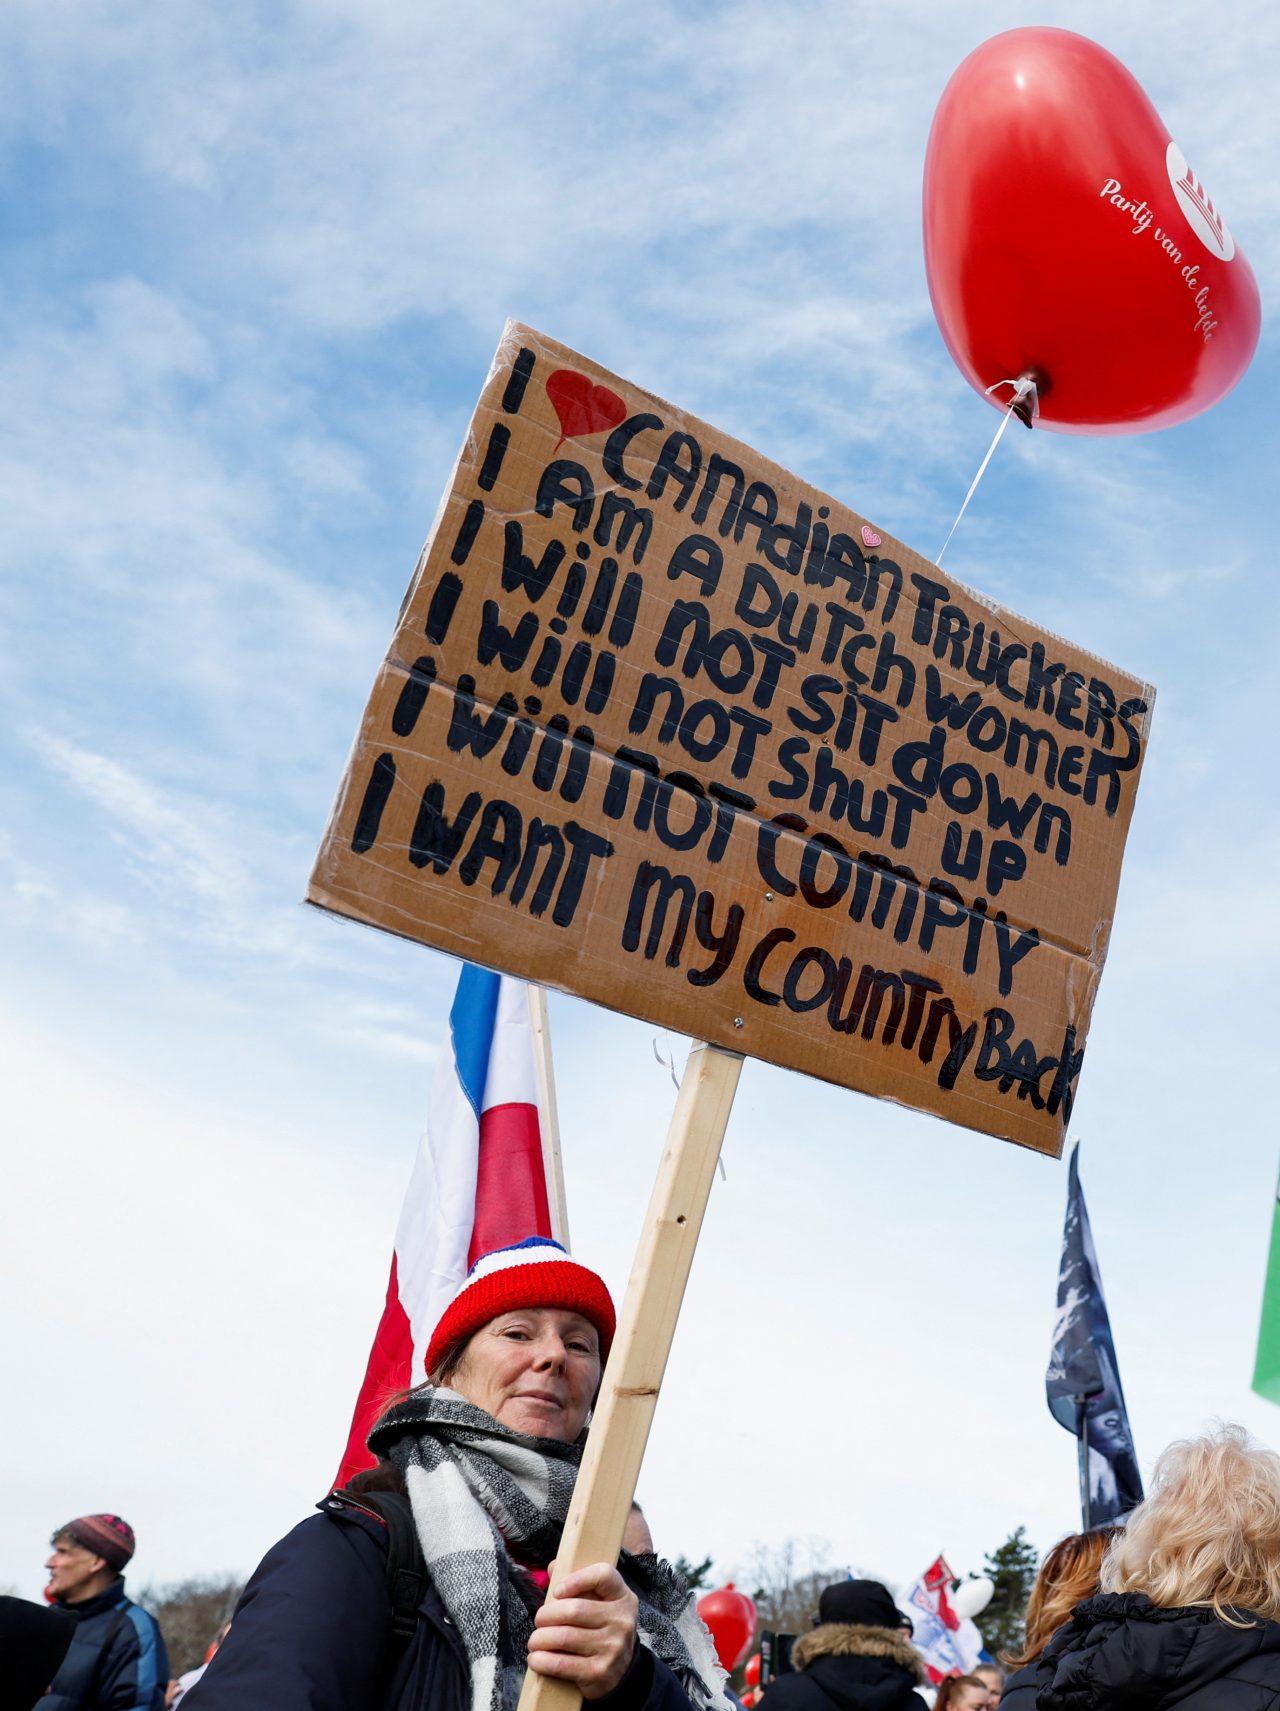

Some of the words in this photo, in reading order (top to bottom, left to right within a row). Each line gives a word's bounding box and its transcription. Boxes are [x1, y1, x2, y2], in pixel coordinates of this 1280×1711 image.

[1100, 178, 1153, 234] Partij
[1154, 228, 1182, 264] van
[1181, 265, 1200, 290] de
[1194, 286, 1218, 343] liefde
[451, 500, 484, 566] I
[478, 422, 511, 491] I
[667, 533, 724, 597] A
[502, 347, 536, 414] I
[910, 572, 1148, 772] TRUCKERS
[425, 572, 464, 646] I
[392, 655, 437, 737] I
[351, 753, 396, 853] I
